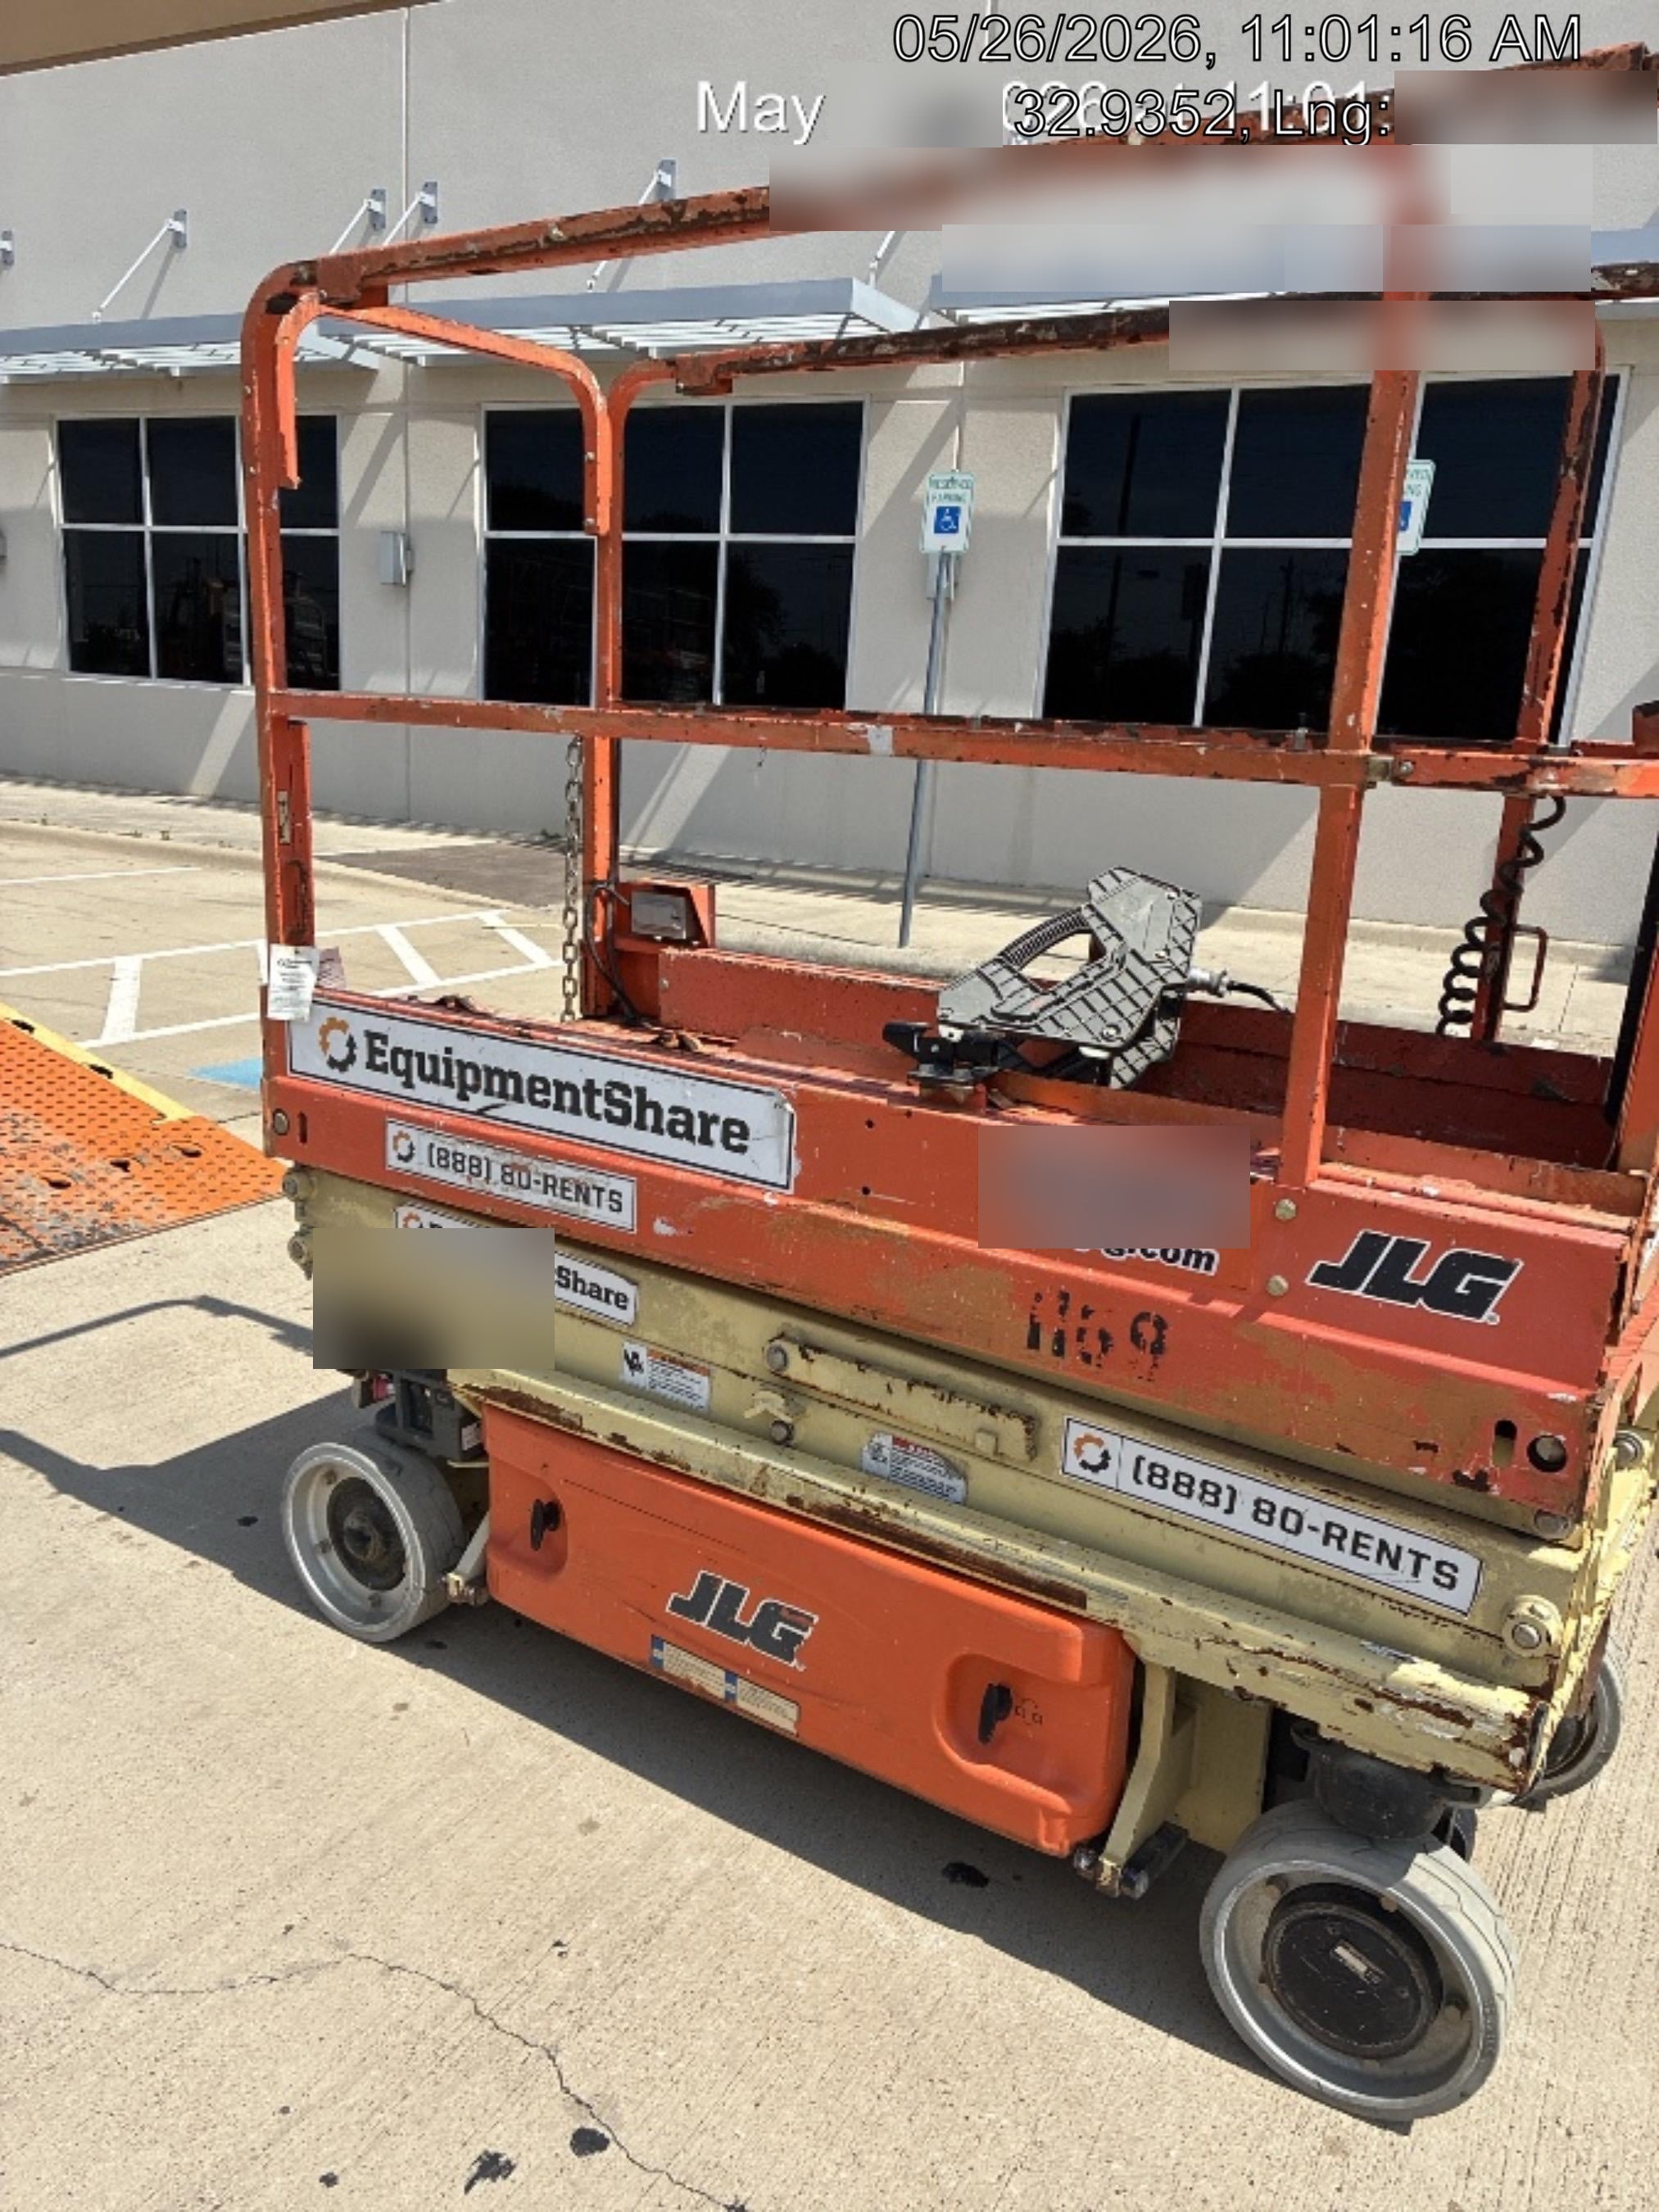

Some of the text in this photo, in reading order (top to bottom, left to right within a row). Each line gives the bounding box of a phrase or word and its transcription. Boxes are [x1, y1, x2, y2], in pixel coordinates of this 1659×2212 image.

[363, 1029, 750, 1155] EquipmentShare
[501, 1163, 623, 1213] 80-RENTS
[1305, 1229, 1525, 1324] JLG
[1132, 1455, 1460, 1592] (888) 80-RENTS
[665, 1569, 819, 1670] JLG
